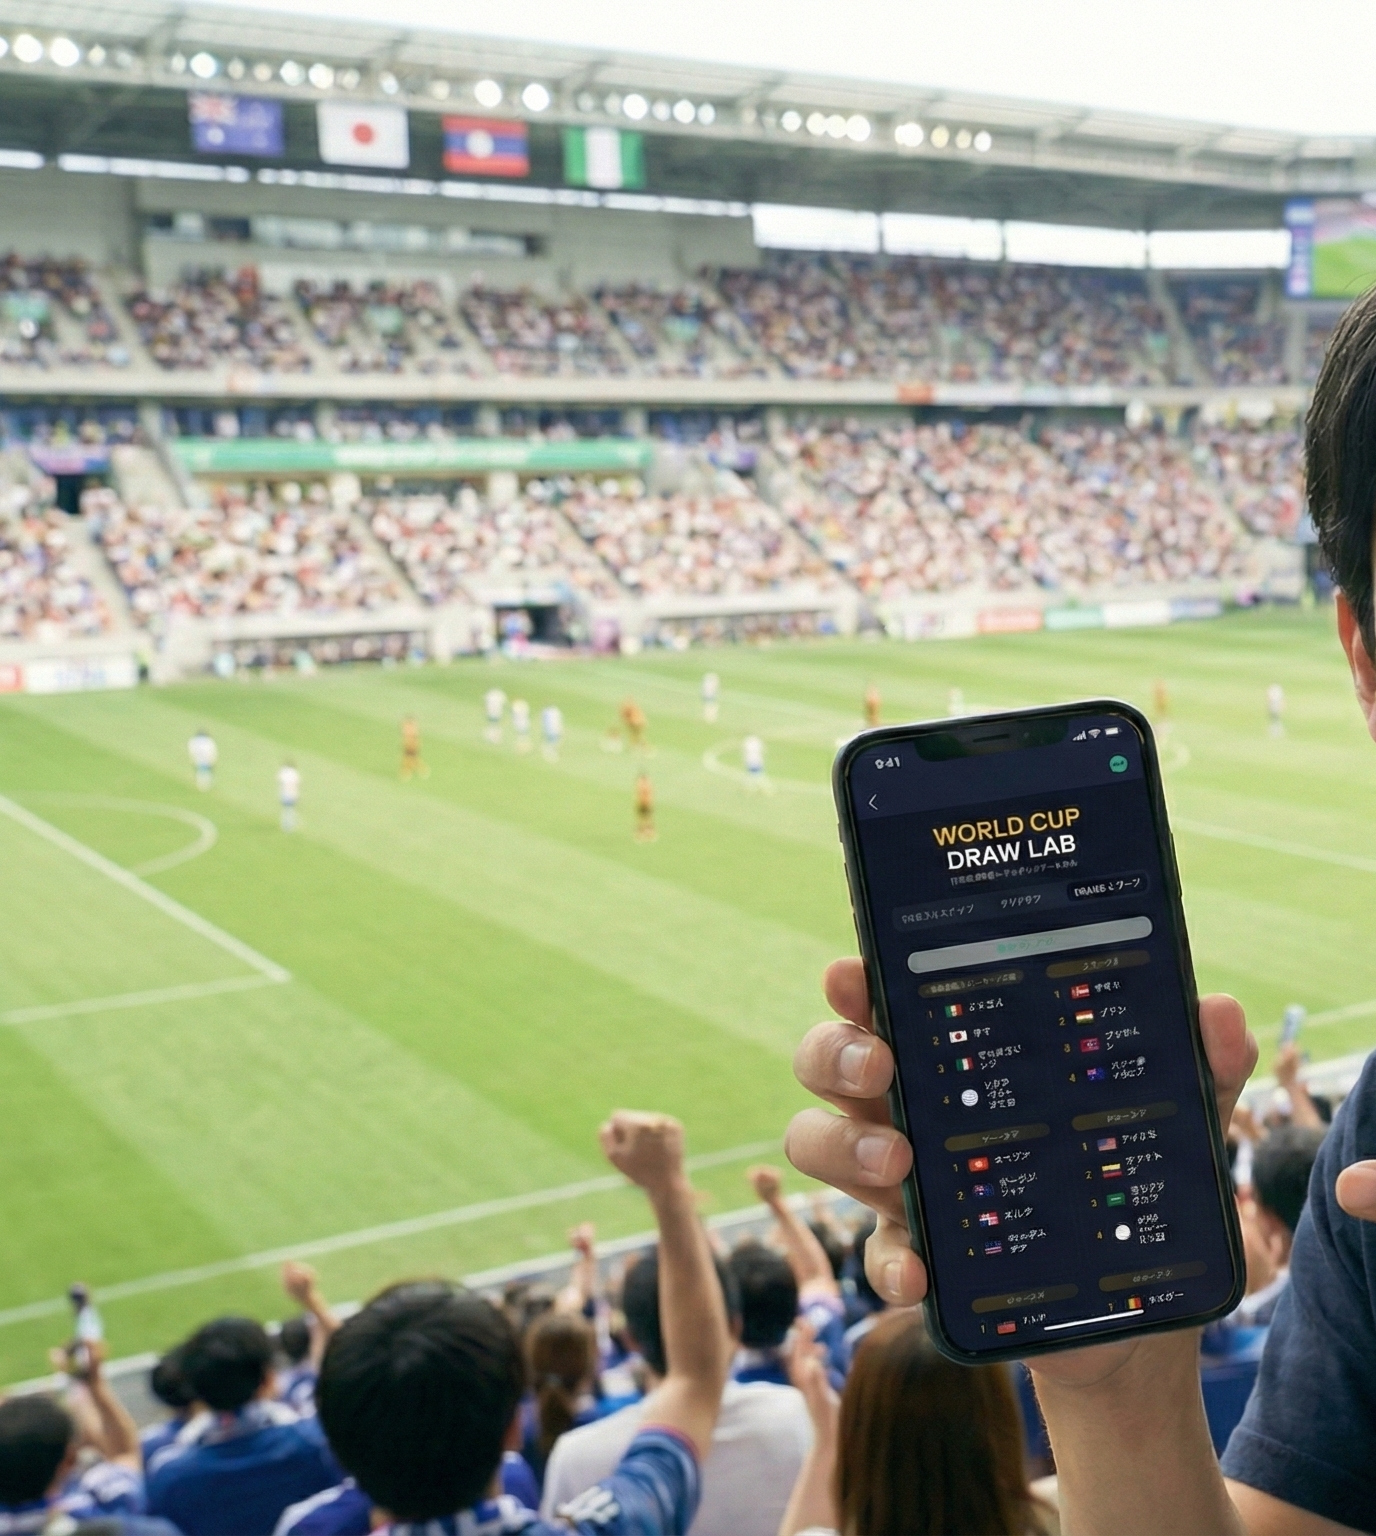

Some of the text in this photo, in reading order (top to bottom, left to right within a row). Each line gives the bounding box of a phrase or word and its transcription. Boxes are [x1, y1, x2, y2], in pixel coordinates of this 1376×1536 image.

[932, 807, 1081, 846] WORLD CUP
[947, 834, 1076, 870] DRAW LAB
[1059, 1017, 1066, 1026] 2
[932, 1036, 940, 1046] 2
[1086, 1170, 1093, 1180] 2
[957, 1191, 965, 1201] 2
